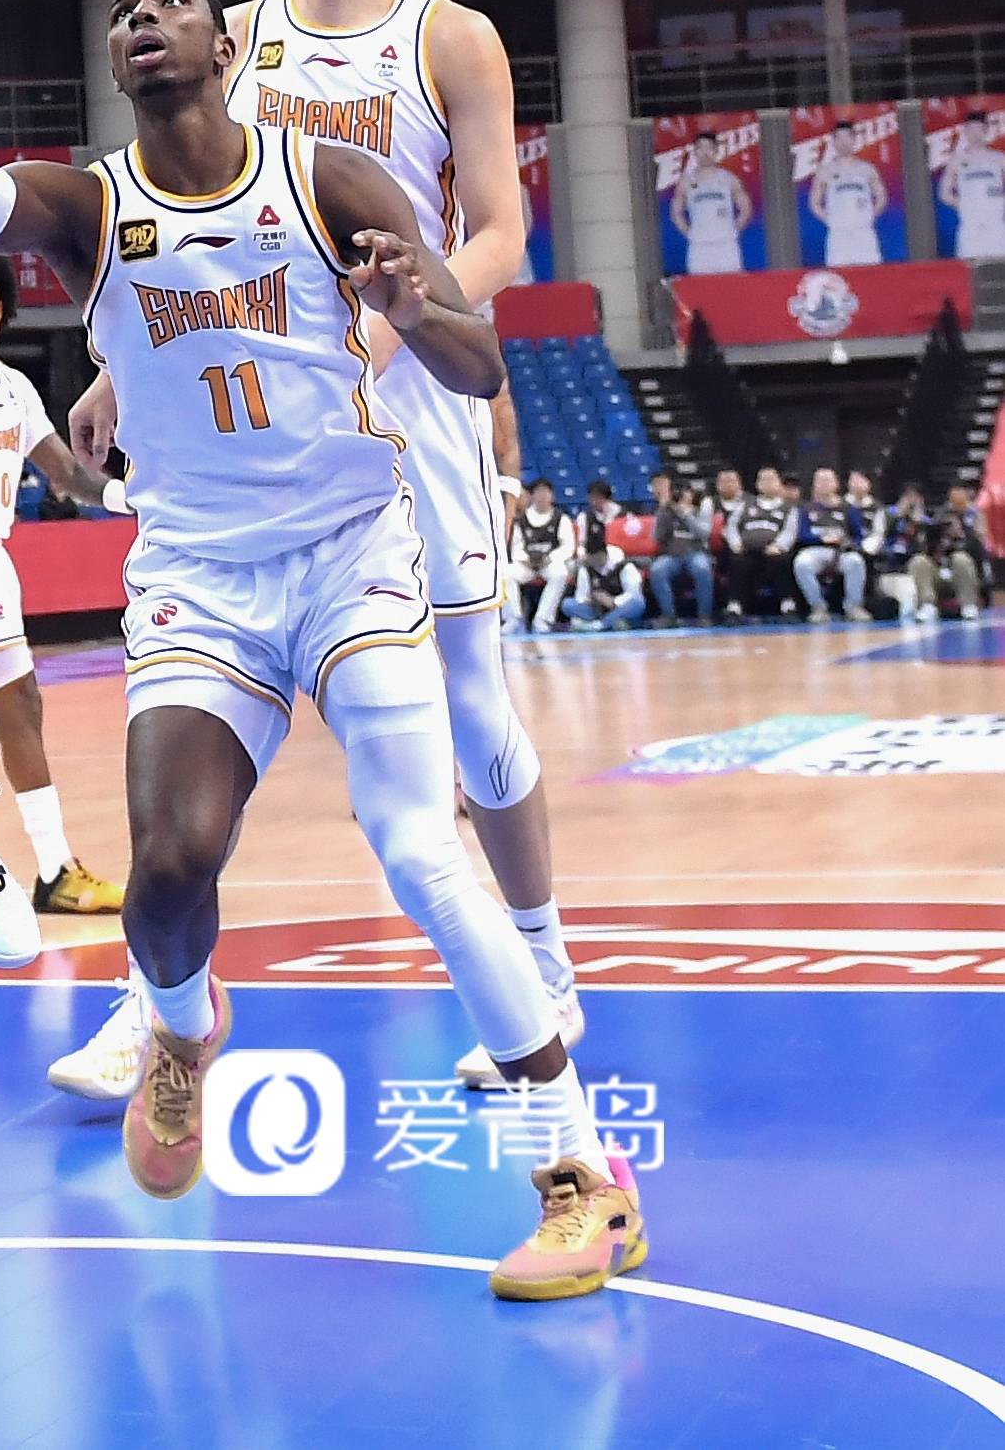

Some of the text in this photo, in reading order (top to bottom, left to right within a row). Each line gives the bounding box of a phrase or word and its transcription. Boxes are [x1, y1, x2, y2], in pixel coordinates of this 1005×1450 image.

[257, 82, 398, 158] SHANXI
[260, 242, 281, 251] CGB
[130, 262, 291, 349] SHANXI
[199, 359, 271, 433] 11
[1, 473, 11, 509] 0
